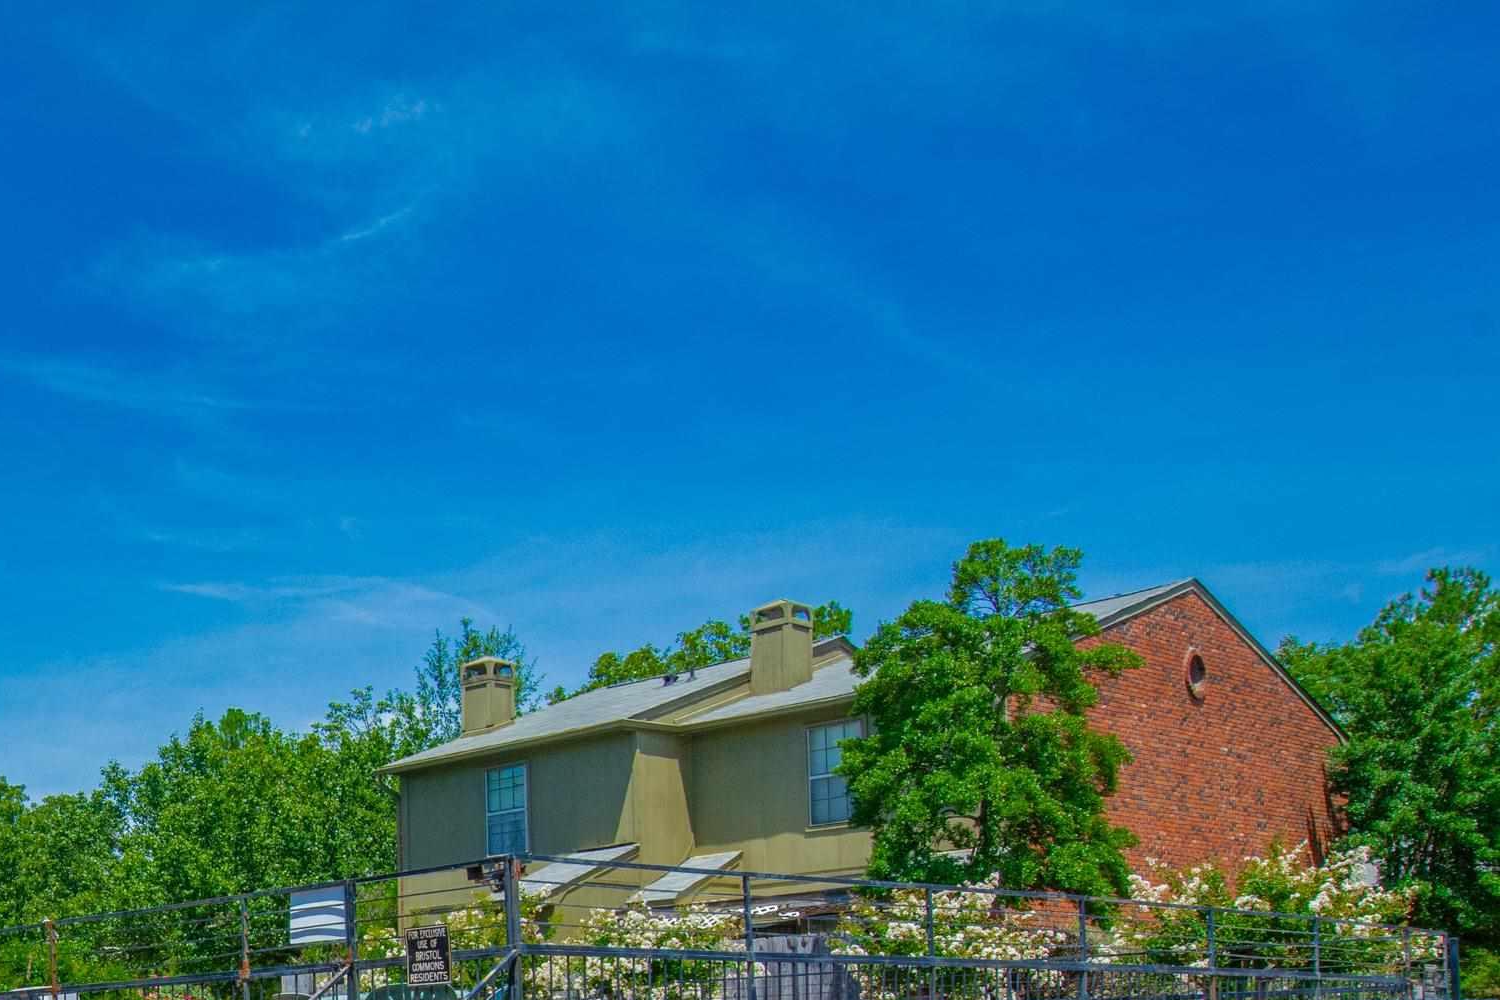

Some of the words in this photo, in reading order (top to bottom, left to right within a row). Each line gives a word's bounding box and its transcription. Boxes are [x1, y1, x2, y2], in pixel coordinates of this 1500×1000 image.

[408, 931, 419, 940] FOR
[420, 928, 446, 939] EXCLUSIVE
[417, 940, 428, 949] USE
[430, 939, 437, 948] OF
[415, 951, 442, 961] BRISTOL
[412, 961, 445, 972] COMMONS
[410, 972, 448, 983] RESIDENTS
